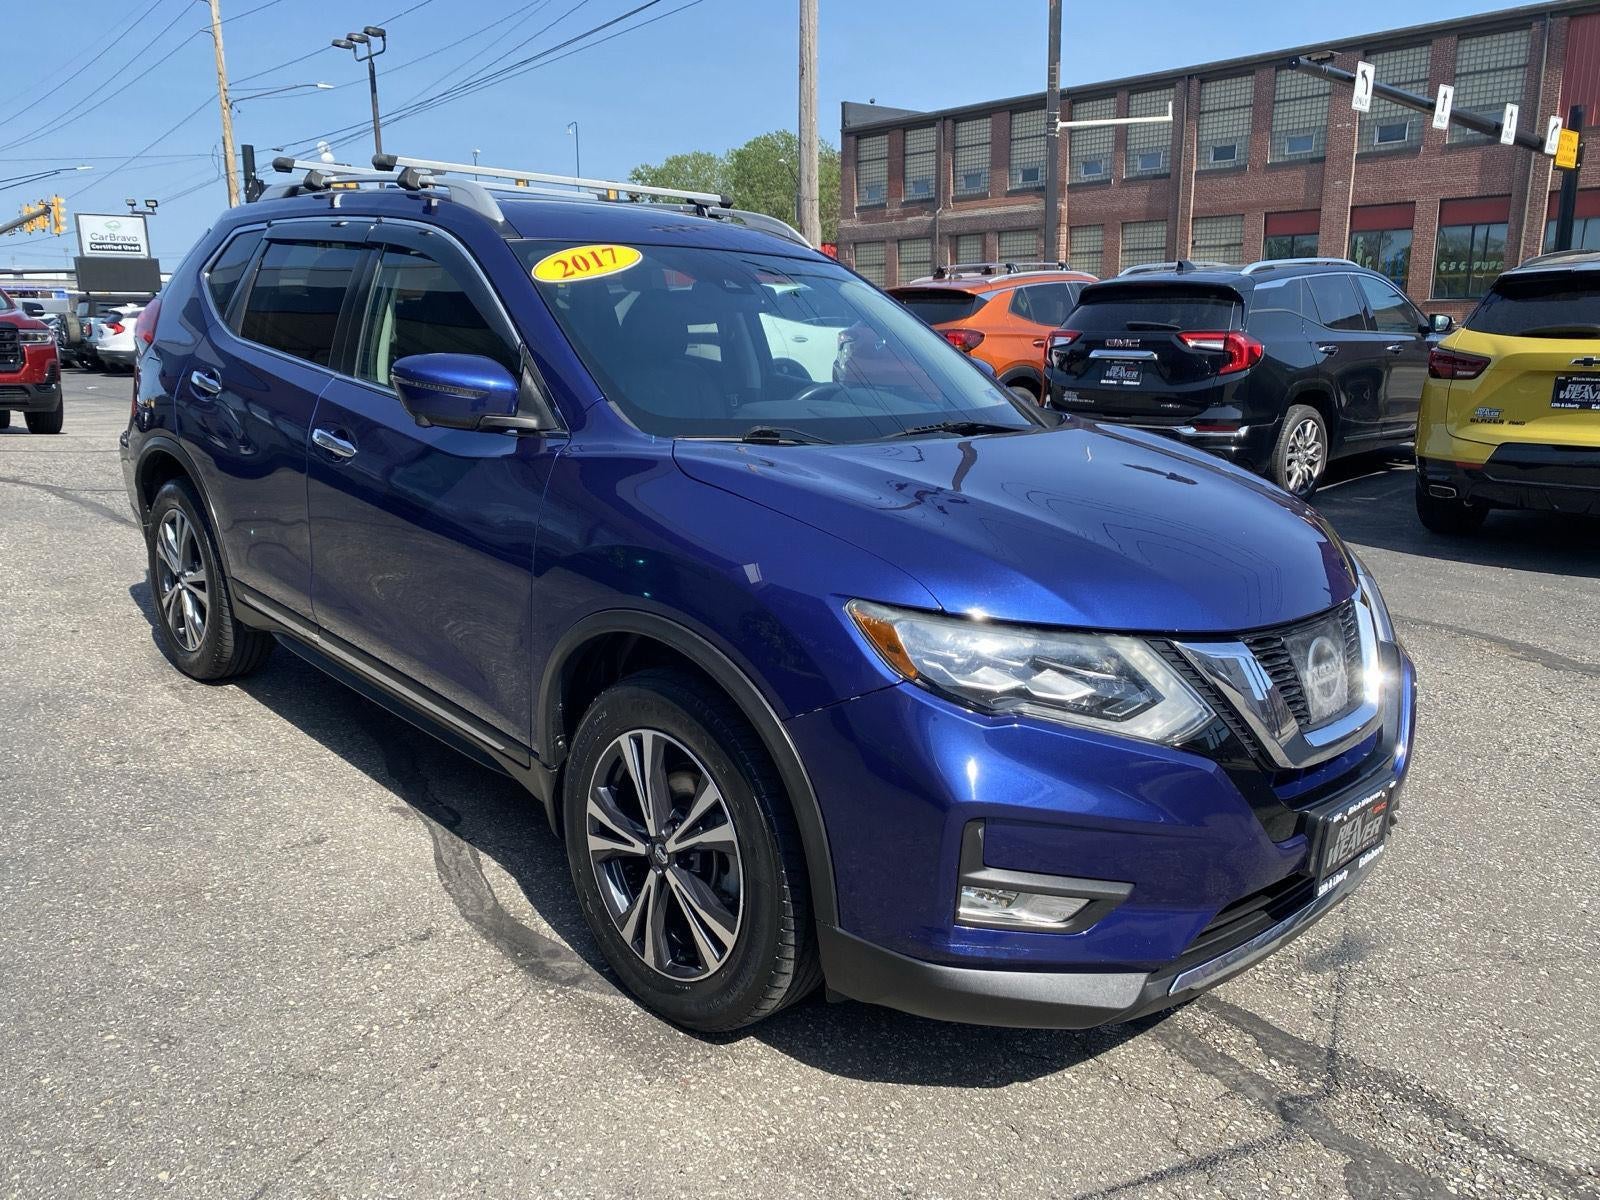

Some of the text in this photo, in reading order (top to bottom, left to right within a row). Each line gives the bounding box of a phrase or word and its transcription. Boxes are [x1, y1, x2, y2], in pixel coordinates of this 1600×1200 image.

[90, 232, 138, 242] CarBravo
[553, 247, 617, 278] 2017
[1105, 338, 1140, 348] GMC
[1567, 383, 1594, 391] RICK
[1336, 810, 1366, 845] RICK
[1326, 815, 1384, 868] WEAVER
